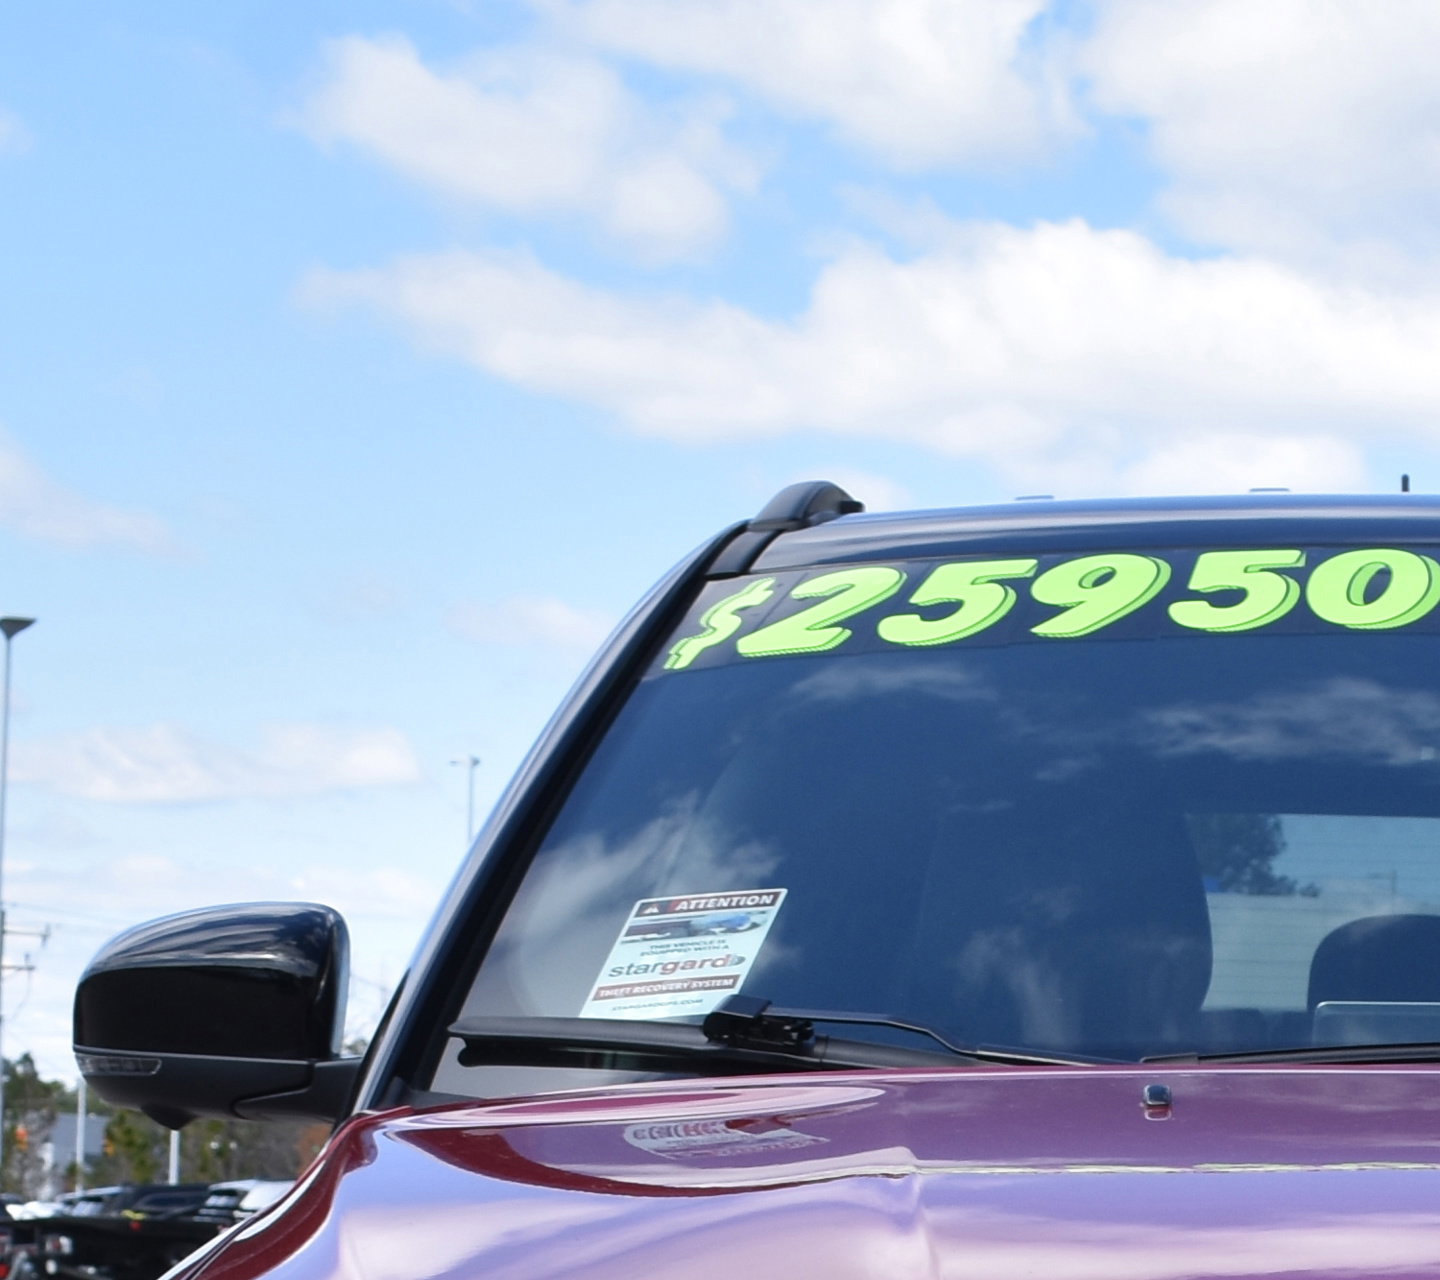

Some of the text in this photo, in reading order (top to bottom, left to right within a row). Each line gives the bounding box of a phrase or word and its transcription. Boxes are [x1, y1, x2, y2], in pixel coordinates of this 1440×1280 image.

[675, 894, 773, 911] ATTENTION
[608, 954, 731, 978] stargard
[598, 977, 735, 998] THEFT RECOVERY SYSTEM
